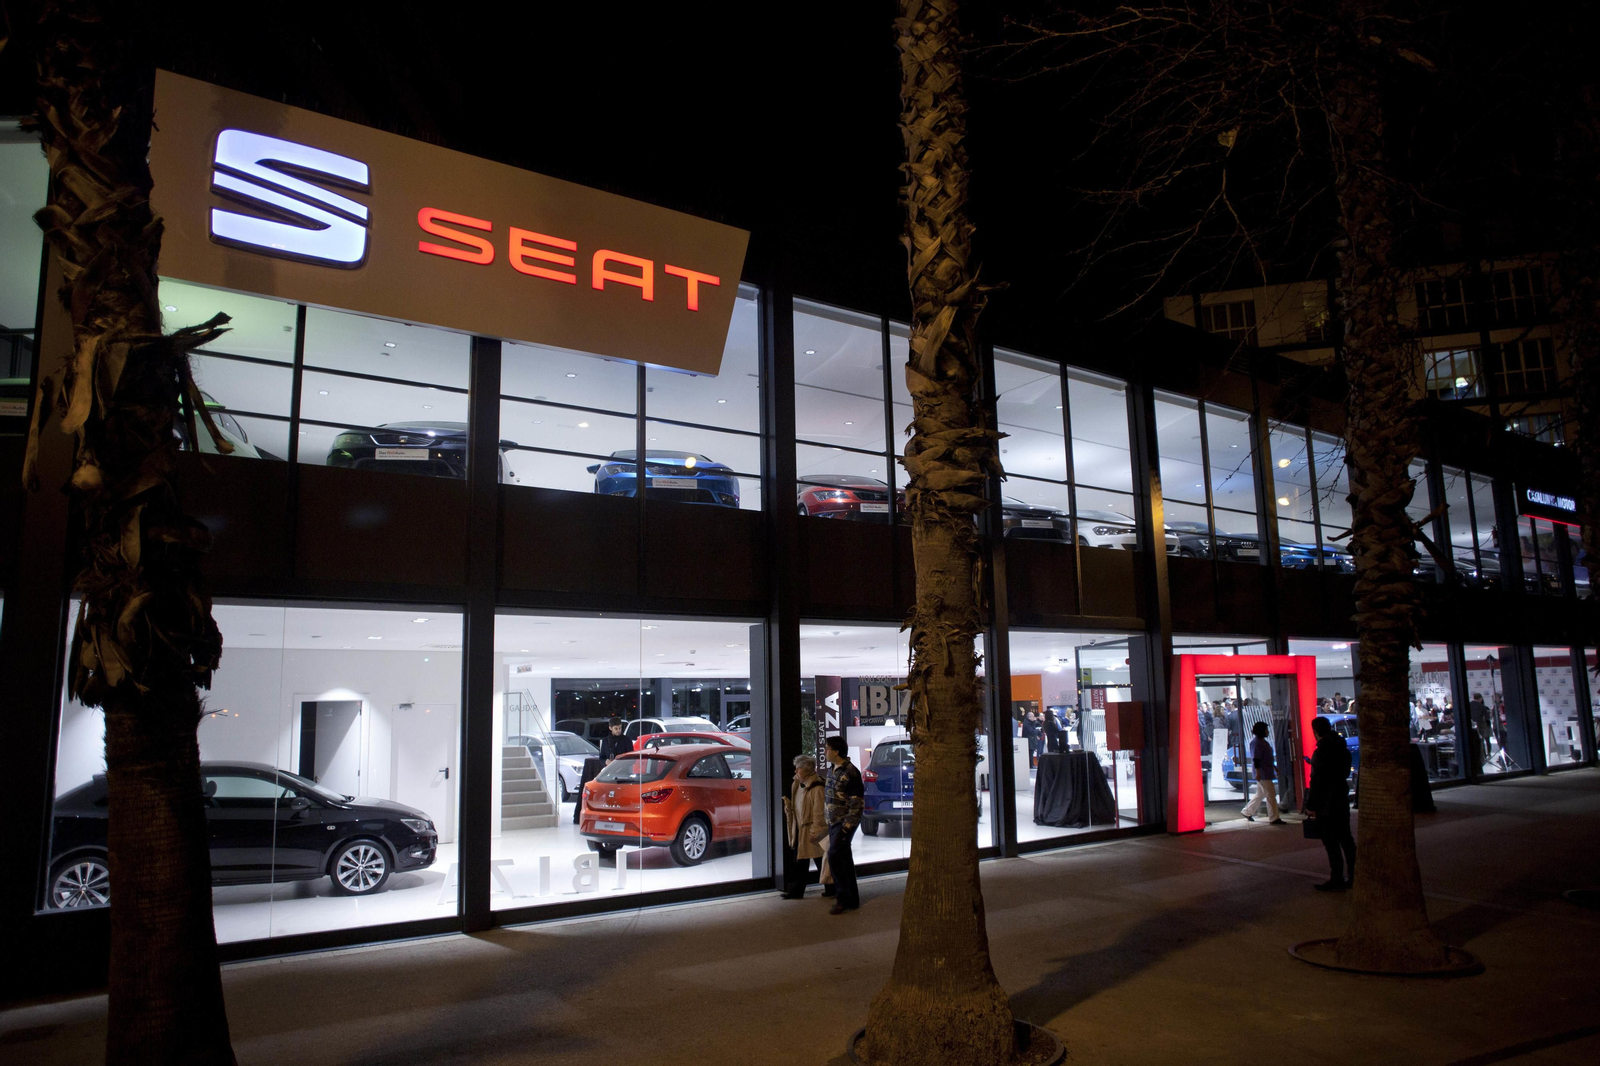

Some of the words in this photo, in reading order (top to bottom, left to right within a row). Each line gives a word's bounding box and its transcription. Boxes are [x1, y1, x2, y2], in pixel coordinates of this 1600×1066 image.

[417, 206, 721, 312] SEAT
[876, 674, 892, 683] SEAT
[1415, 687, 1445, 695] RIENCE
[825, 691, 840, 739] IZA
[859, 685, 912, 717] IBIZ
